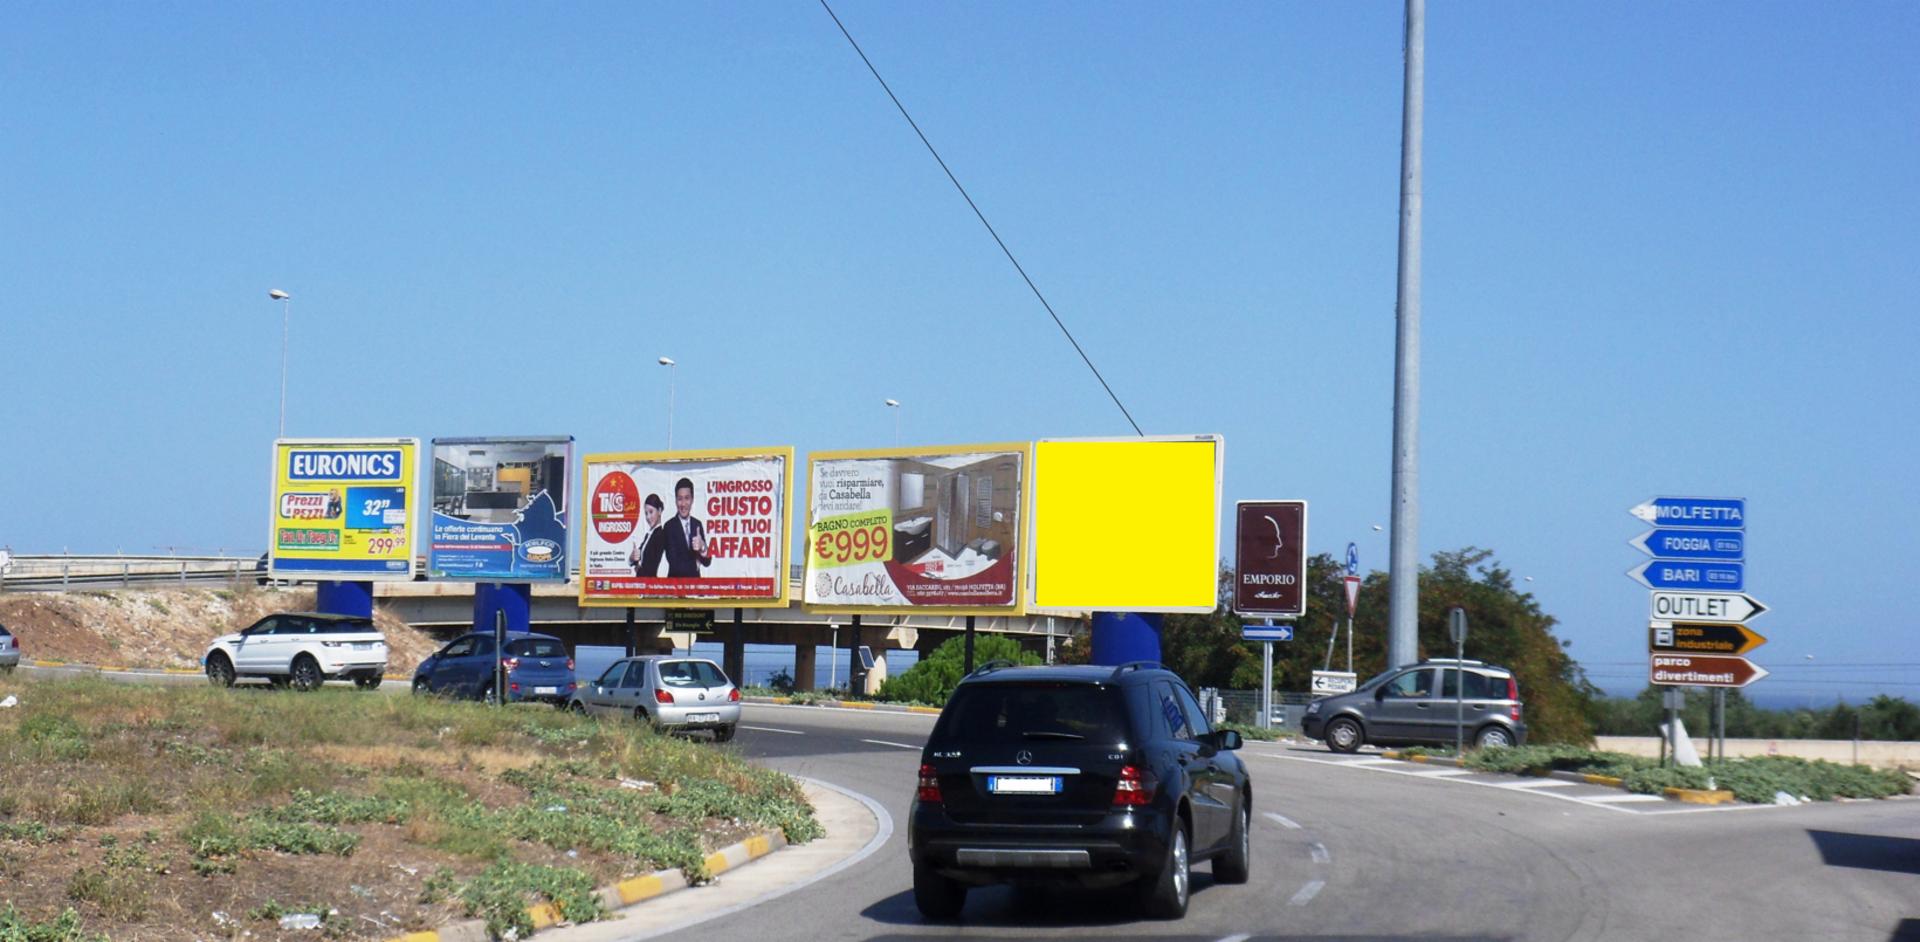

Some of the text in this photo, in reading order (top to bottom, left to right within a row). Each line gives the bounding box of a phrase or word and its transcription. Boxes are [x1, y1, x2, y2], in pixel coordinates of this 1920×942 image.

[293, 454, 394, 476] EURONICS
[820, 467, 859, 477] Se davvero
[707, 480, 773, 493] L'INGROSSO
[836, 477, 885, 489] risparmiare,
[818, 488, 871, 500] da Casabella
[287, 495, 323, 506] Prezzi
[707, 496, 772, 516] GIUSTO
[1657, 506, 1742, 520] MOLFETTA
[434, 525, 503, 533] Le offerte continuano
[598, 521, 632, 533] INGROSSO
[707, 519, 771, 534] PER I TUOI
[817, 516, 888, 532] BAGNO COMPLETO
[442, 533, 458, 541] Fiera
[460, 533, 469, 541] del
[471, 533, 496, 541] Levante
[707, 537, 771, 558] AFFARI
[815, 526, 888, 562] €999
[1665, 537, 1711, 551] FOGGIA
[1243, 574, 1295, 585] EMPORIO
[1664, 569, 1700, 581] BARI
[834, 572, 889, 599] Casabella
[1657, 597, 1730, 616] OUTLET
[1677, 628, 1703, 636] zona
[1677, 639, 1734, 650] industriale
[1655, 657, 1691, 667] parco
[1655, 671, 1734, 682] divertimenti
